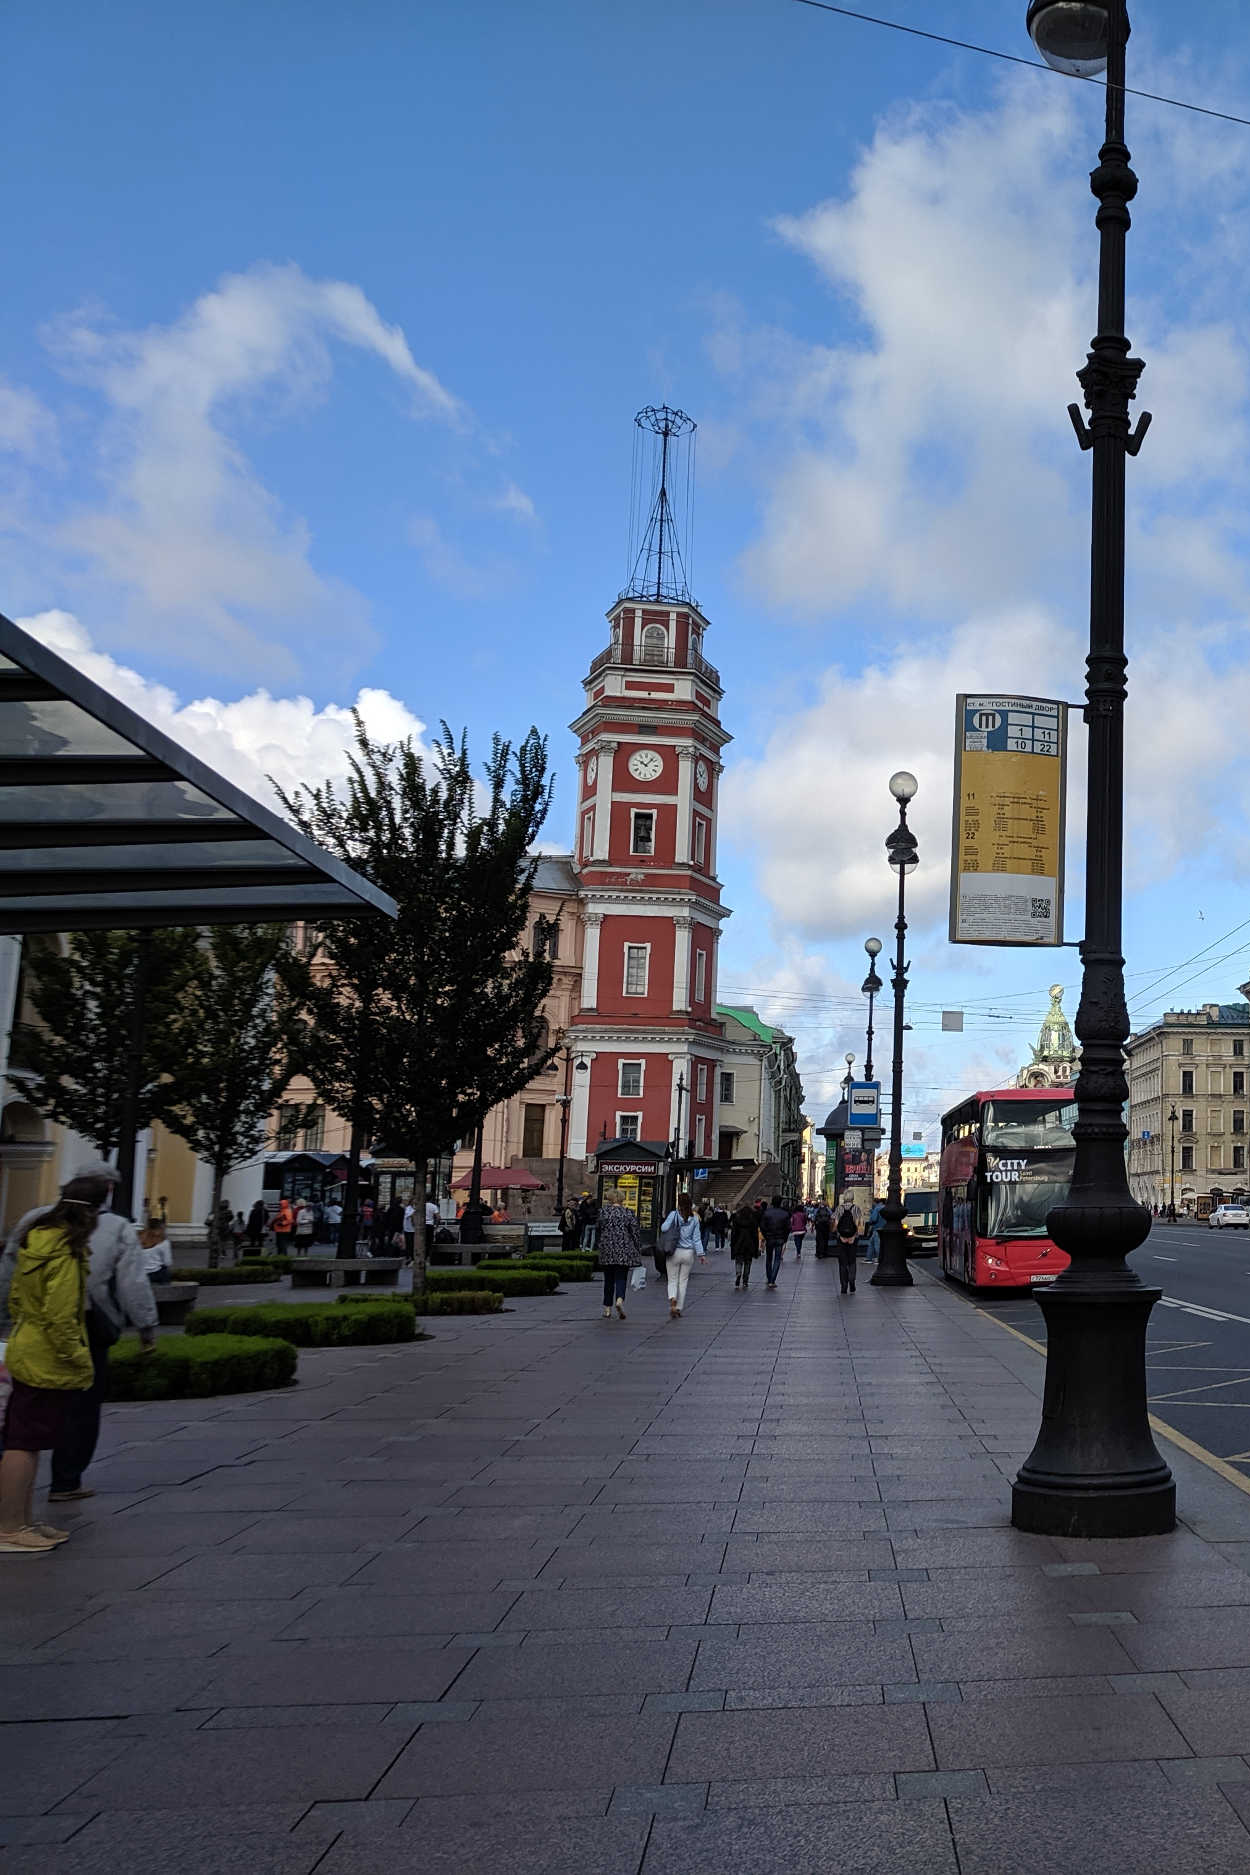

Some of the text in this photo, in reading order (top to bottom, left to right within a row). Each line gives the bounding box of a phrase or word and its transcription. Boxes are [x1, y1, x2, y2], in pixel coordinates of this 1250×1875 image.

[1019, 728, 1052, 740] 1 11
[1015, 741, 1052, 753] 10 22
[967, 792, 975, 800] 11
[965, 832, 976, 840] 22
[601, 1164, 655, 1173] ЭКСКУРСИИ
[998, 1159, 1028, 1171] CITY
[985, 1171, 1020, 1183] TOUR
